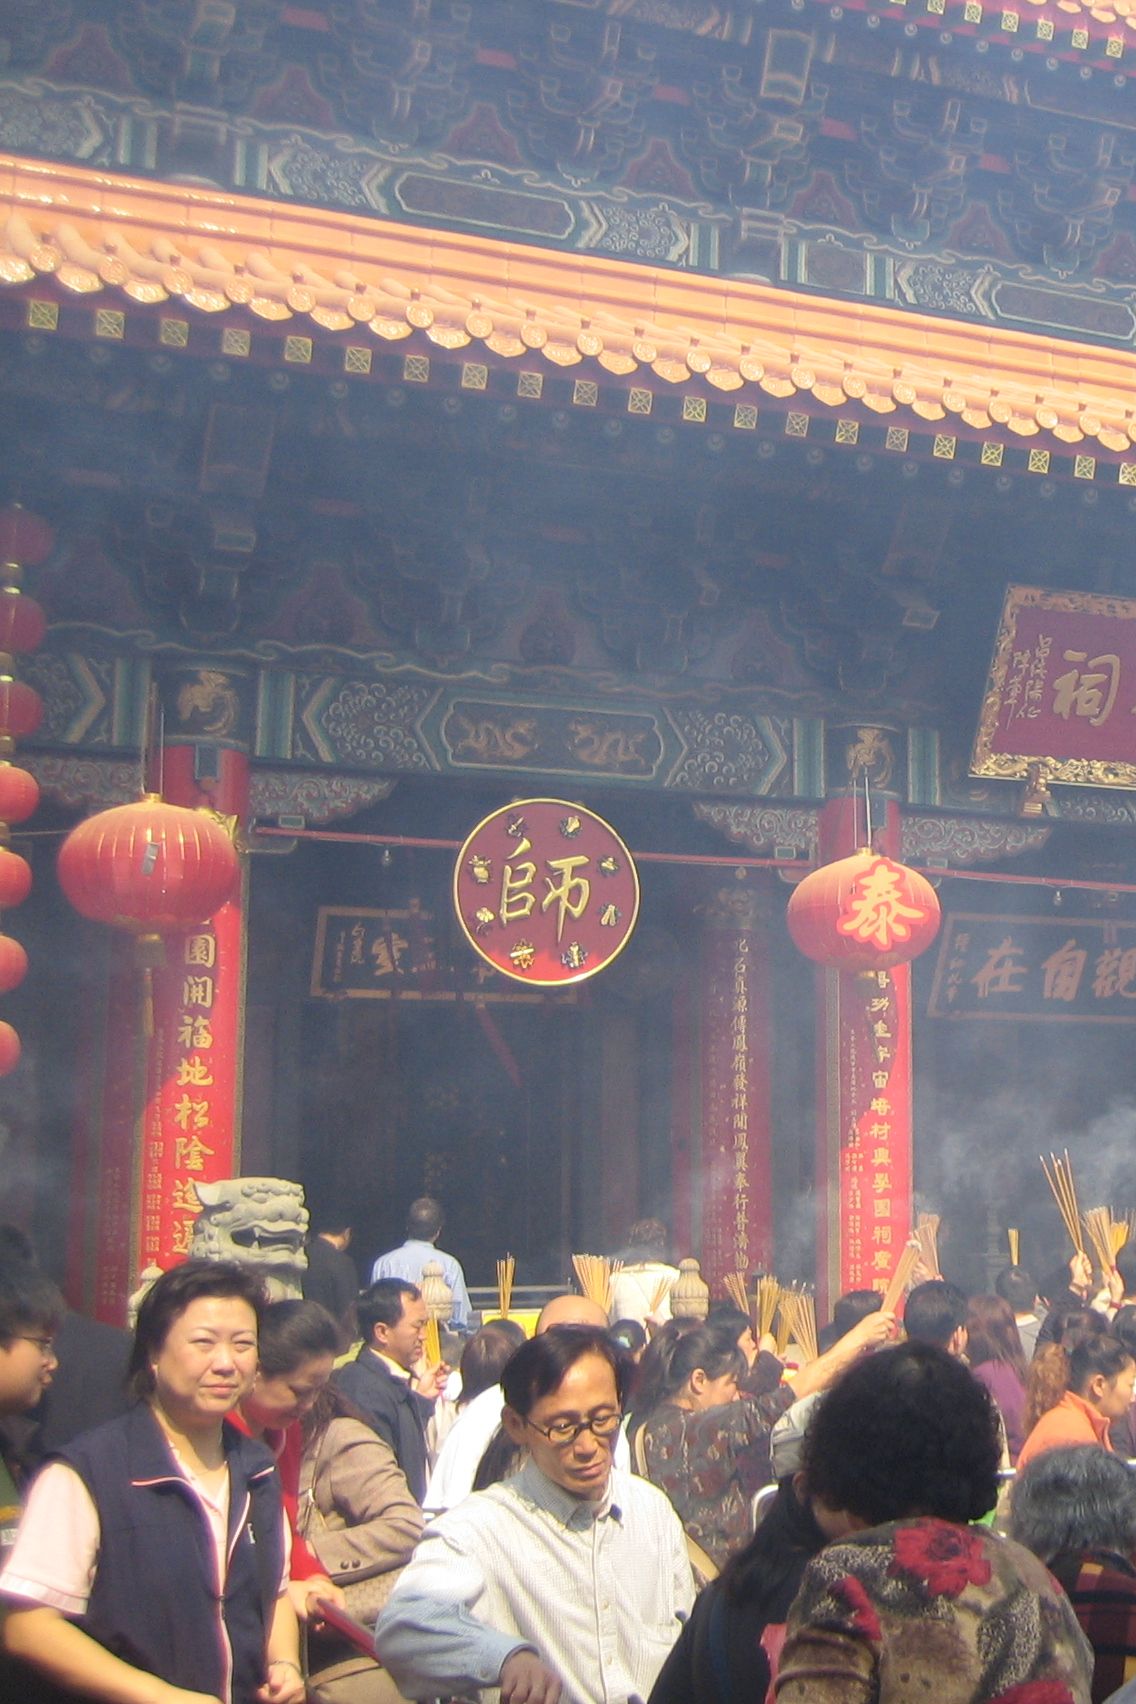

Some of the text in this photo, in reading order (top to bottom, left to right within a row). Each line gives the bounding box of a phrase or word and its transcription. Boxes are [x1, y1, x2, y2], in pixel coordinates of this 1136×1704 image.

[500, 837, 591, 943] 師
[842, 863, 925, 946] 泰
[171, 917, 217, 1255] 園開福地松陰
